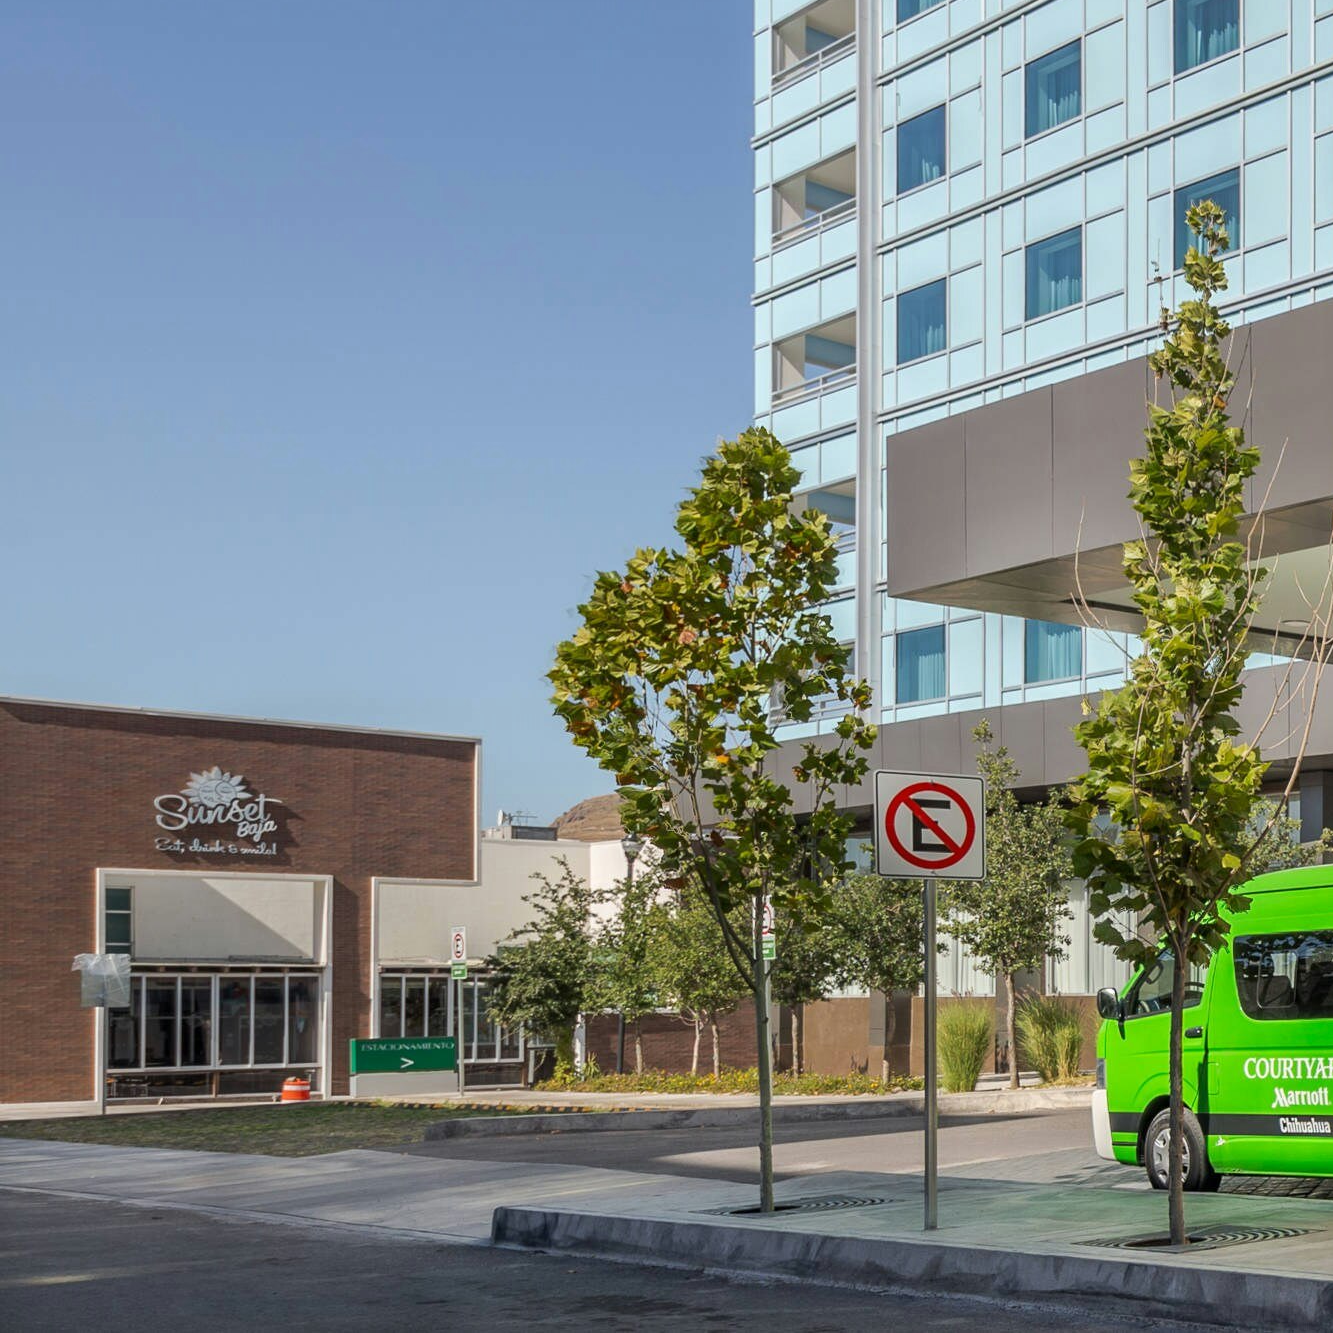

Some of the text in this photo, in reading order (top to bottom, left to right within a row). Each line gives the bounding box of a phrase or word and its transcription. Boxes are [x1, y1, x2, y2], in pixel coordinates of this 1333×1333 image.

[153, 793, 283, 831] Sunset
[236, 819, 278, 843] Baja
[154, 837, 185, 853] Eat,
[188, 837, 227, 854] drink
[361, 1042, 455, 1052] ESTACIONAMIENTO
[1271, 1086, 1330, 1108] Marriott
[1279, 1117, 1331, 1134] Chihuahua
